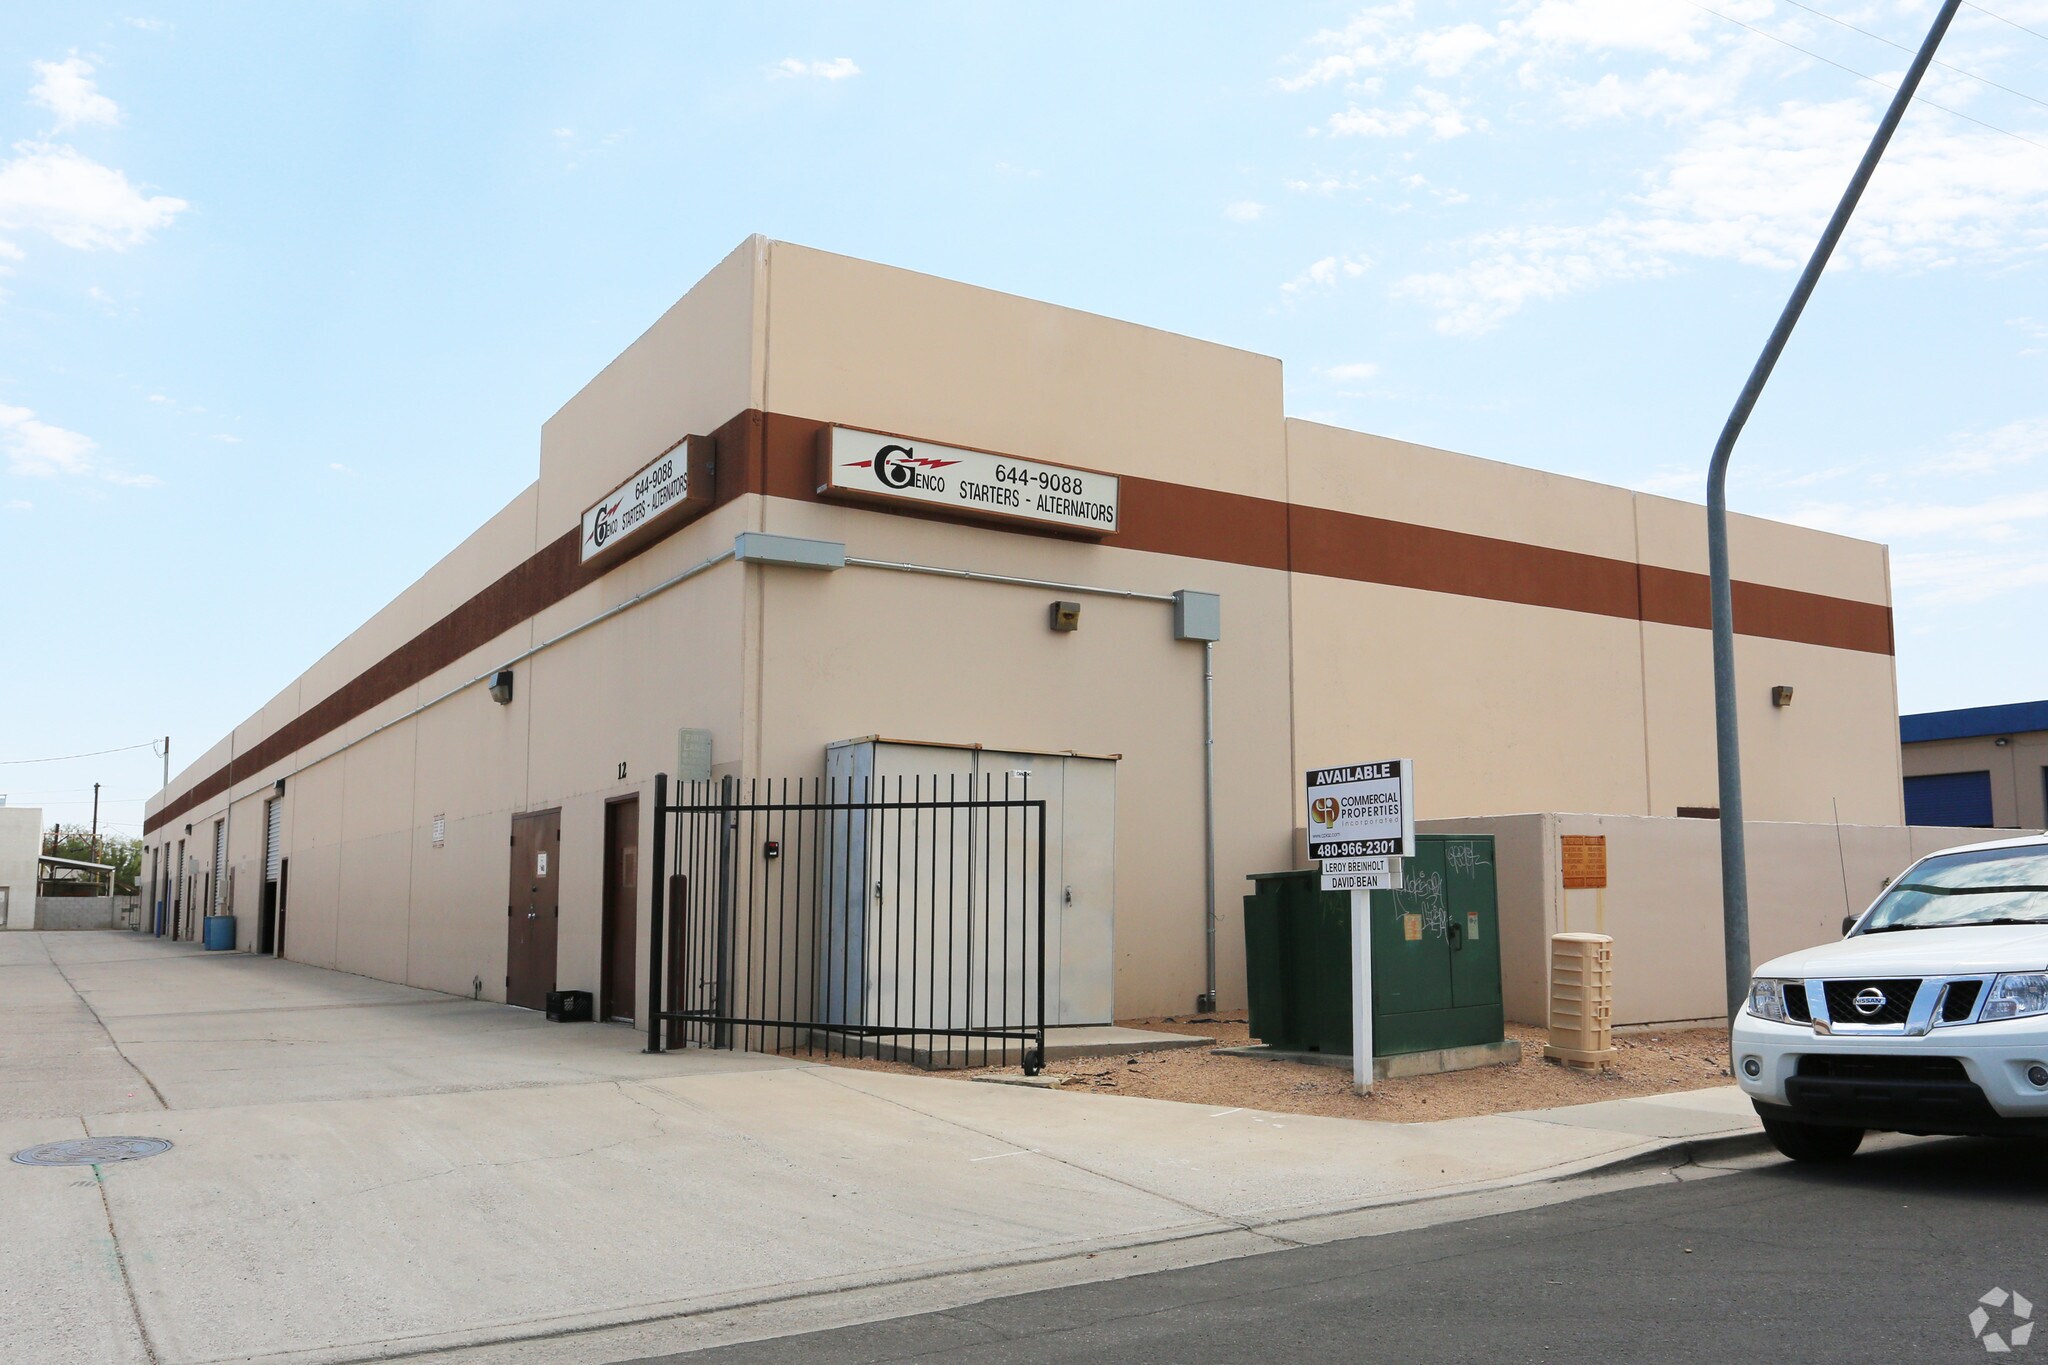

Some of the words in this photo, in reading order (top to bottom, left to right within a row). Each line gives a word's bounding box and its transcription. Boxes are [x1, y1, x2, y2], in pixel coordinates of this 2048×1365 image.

[635, 460, 673, 500] 644-9088
[874, 445, 945, 492] GENCO
[959, 480, 1020, 508] STARTERS
[1036, 494, 1114, 523] ALTERNATORS
[995, 464, 1083, 496] 644-9088
[622, 500, 646, 530] STARTERS
[651, 472, 687, 511] ALTERNATORS
[617, 761, 627, 780] 12
[1316, 763, 1391, 785] AVAILABLE
[1341, 792, 1398, 807] COMMERCIAL
[1341, 804, 1399, 819] PROPERTIES
[1317, 840, 1395, 857] 480-966-2301
[1325, 861, 1346, 873] LEROY
[1348, 860, 1384, 872] BREINHOLT
[1332, 877, 1354, 888] DAVID
[1356, 876, 1378, 887] BEAN
